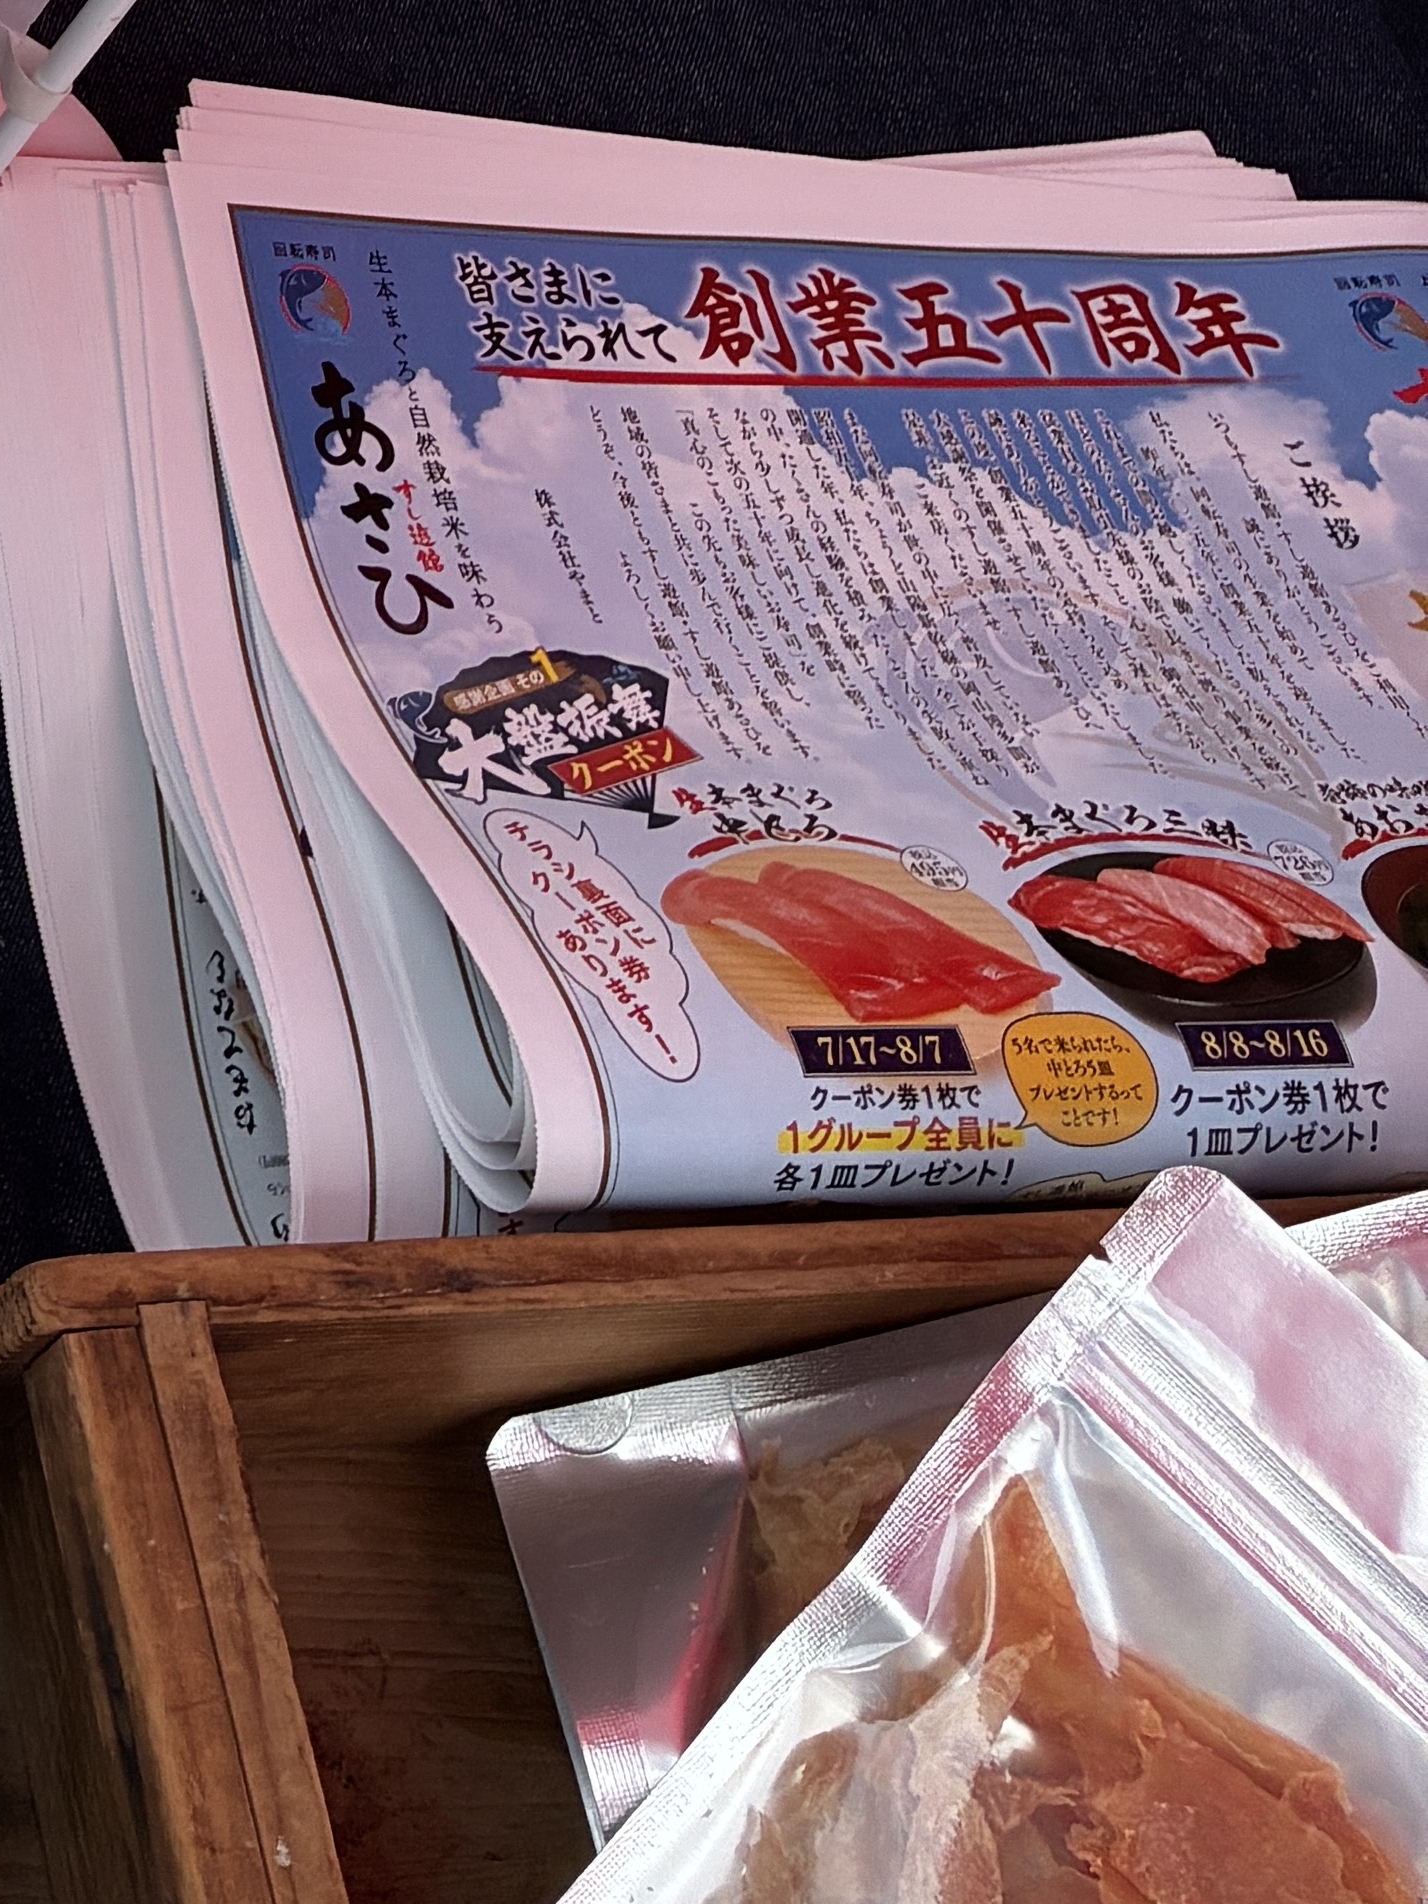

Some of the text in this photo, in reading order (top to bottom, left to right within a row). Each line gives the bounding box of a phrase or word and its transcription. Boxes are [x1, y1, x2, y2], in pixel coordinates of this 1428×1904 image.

[456, 255, 622, 307] 皆さまに
[684, 266, 1283, 378] 創業五十周年
[474, 311, 678, 363] 支えられて
[369, 251, 504, 634] 生本まぐろと自然栽培米を味わう
[311, 361, 454, 635] あさひ
[393, 479, 444, 572] すし遊館
[1283, 439, 1361, 549] ご挨拶
[535, 489, 603, 624] 株式会社やまと
[439, 682, 660, 804] 大盤振舞
[570, 734, 675, 788] クーポン
[504, 820, 657, 947] チラシ裏面に
[532, 872, 651, 983] クーポン券
[1011, 1034, 1132, 1058] 5名で来られたら、
[785, 1117, 1014, 1153] 1グループ全員に
[811, 1083, 981, 1113] クーポン券1枚で
[1030, 1083, 1143, 1105] プレゼントするって
[1171, 1082, 1390, 1117] クーポン券1枚で
